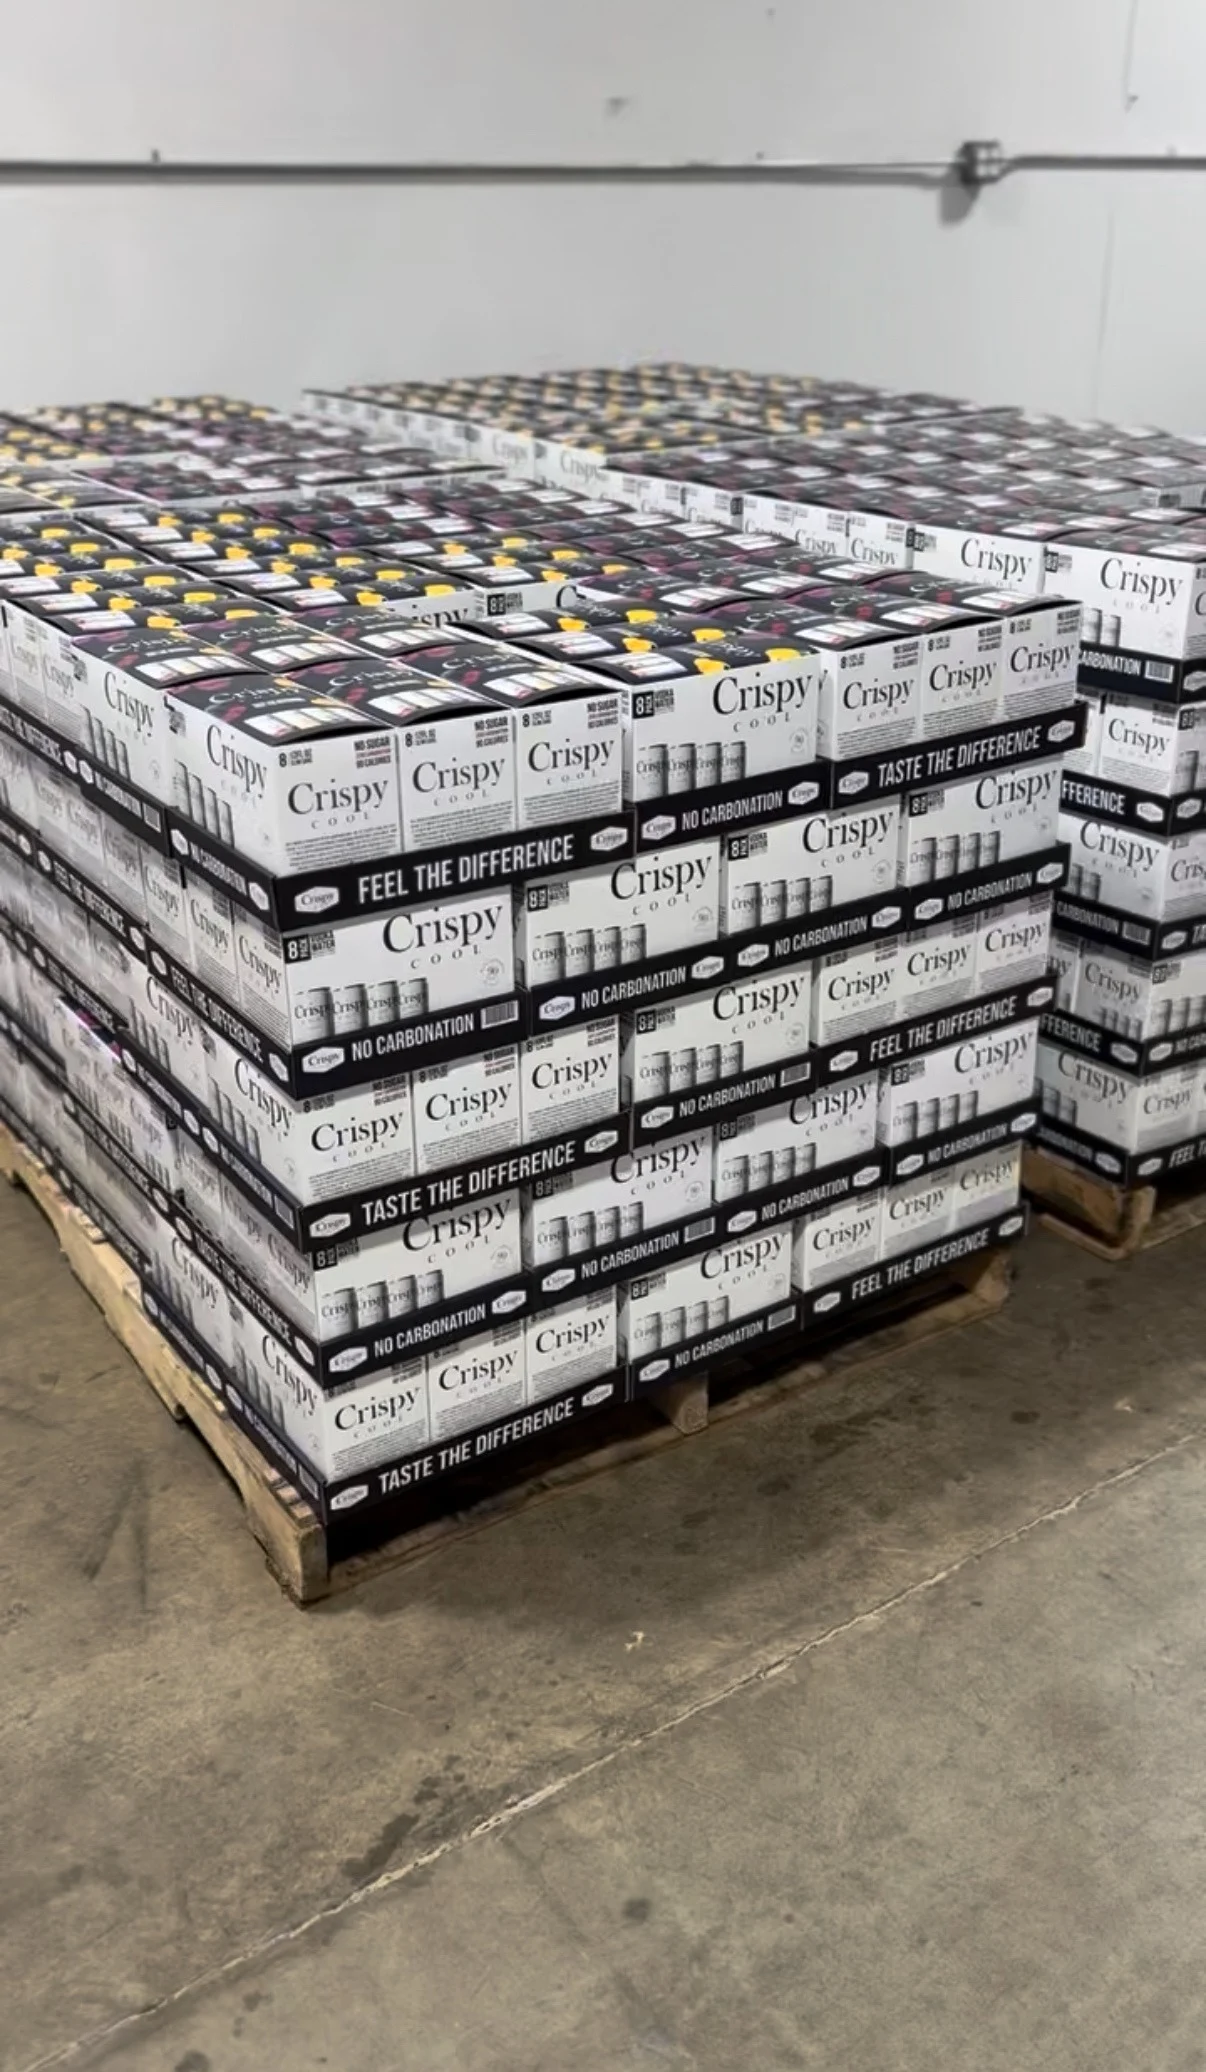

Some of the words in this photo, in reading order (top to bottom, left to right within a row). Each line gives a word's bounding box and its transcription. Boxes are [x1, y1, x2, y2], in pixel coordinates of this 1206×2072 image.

[961, 537, 1032, 582] Crispy
[1101, 557, 1183, 606] Crispy
[929, 660, 998, 691] Crispy
[1010, 643, 1075, 673] Crispy
[1081, 650, 1141, 676] ARBONATION
[636, 697, 644, 715] 8
[713, 672, 813, 715] Crispy
[843, 678, 914, 710] Crispy
[474, 719, 485, 731] NO
[485, 716, 508, 729] SUGAR
[522, 712, 530, 727] 8
[733, 714, 790, 733] COOL
[1108, 718, 1170, 756] Crispy
[354, 738, 365, 750] NO
[365, 736, 391, 749] SUGAR
[405, 732, 413, 747] 8
[528, 738, 615, 773] Crispy
[877, 755, 923, 788] TASTE
[926, 747, 954, 776] THE
[957, 725, 1043, 769] DIFFERENCE
[206, 724, 268, 799] Crispy
[279, 753, 287, 767] 8
[412, 757, 505, 793] Crispy
[546, 769, 599, 785] COOL
[287, 778, 388, 815] Crispy
[433, 789, 490, 806] COOL
[975, 769, 1057, 810] Crispy
[1061, 780, 1126, 815] FFERENCE
[311, 812, 372, 829] COOL
[682, 811, 698, 831] NO
[701, 790, 783, 826] CARBONATION
[730, 838, 739, 857] 8
[803, 811, 893, 853] Crispy
[1080, 820, 1160, 872] Crispy
[358, 870, 408, 904] FEEL
[413, 859, 454, 892] THE
[458, 834, 575, 883] DIFFERENCE
[820, 847, 875, 869] COOL
[610, 855, 712, 900] Crispy
[948, 891, 963, 910] NO
[964, 871, 1033, 906] CARBONATION
[528, 890, 537, 909] 8
[632, 893, 690, 916] COOL
[190, 899, 229, 954] Crispy
[382, 906, 503, 953] Crispy
[774, 938, 790, 957] NO
[792, 915, 868, 951] CARBONATION
[985, 922, 1046, 953] Crispy
[239, 935, 282, 994] Crispy
[287, 941, 298, 960] 8
[410, 944, 480, 970] COOL
[907, 945, 971, 976] Crispy
[581, 989, 599, 1010] NO
[602, 966, 687, 1004] CARBONATION
[713, 976, 804, 1021] Crispy
[828, 968, 895, 1001] Crispy
[1085, 962, 1140, 1004] Crispy
[146, 975, 194, 1046] Crispy
[639, 1014, 647, 1031] 8
[732, 1011, 785, 1034] COOL
[870, 1035, 903, 1062] FEEL
[907, 1023, 934, 1049] THE
[936, 996, 1018, 1041] DIFFERENCE
[352, 1039, 372, 1062] NO
[376, 1013, 475, 1051] CARBONATION
[1041, 1013, 1101, 1052] FFERENCE
[532, 1054, 612, 1090] Crispy
[954, 1032, 1034, 1074] Crispy
[419, 1070, 426, 1083] 8
[549, 1081, 597, 1100] COOL
[1058, 1051, 1127, 1105] Crispy
[235, 1058, 292, 1137] Crispy
[303, 1100, 311, 1113] 8
[425, 1083, 512, 1121] Crispy
[679, 1097, 696, 1118] NO
[698, 1074, 776, 1112] CARBONATION
[789, 1080, 872, 1125] Crispy
[311, 1112, 403, 1152] Crispy
[942, 1123, 1007, 1158] CARBONATION
[332, 1141, 387, 1162] COOL
[610, 1136, 706, 1183] Crispy
[362, 1189, 422, 1226] TASTE
[426, 1176, 464, 1207] THE
[468, 1140, 577, 1195] DIFFERENCE
[631, 1172, 685, 1195] COOL
[960, 1157, 1018, 1190] Crispy
[761, 1202, 777, 1220] NO
[779, 1177, 849, 1214] CARBONATION
[889, 1188, 948, 1220] Crispy
[402, 1199, 512, 1251] Crispy
[812, 1216, 875, 1252] Crispy
[316, 1252, 325, 1268] 8
[427, 1236, 491, 1264] COOL
[581, 1261, 599, 1280] NO
[601, 1231, 679, 1275] CARBONATION
[700, 1232, 787, 1279] Crispy
[852, 1275, 882, 1300] FEEL
[887, 1261, 912, 1285] THE
[914, 1227, 991, 1274] DIFFERENCE
[374, 1337, 393, 1358] NO
[396, 1303, 487, 1350] CARBONATION
[535, 1315, 610, 1355] Crispy
[675, 1351, 691, 1368] NO
[692, 1320, 765, 1361] CARBONATION
[263, 1335, 318, 1416] Crispy
[438, 1350, 518, 1391] Crispy
[334, 1387, 421, 1431] Crispy
[379, 1456, 433, 1494] TASTE
[439, 1441, 473, 1471] THE
[476, 1397, 575, 1456] DIFFERENCE
